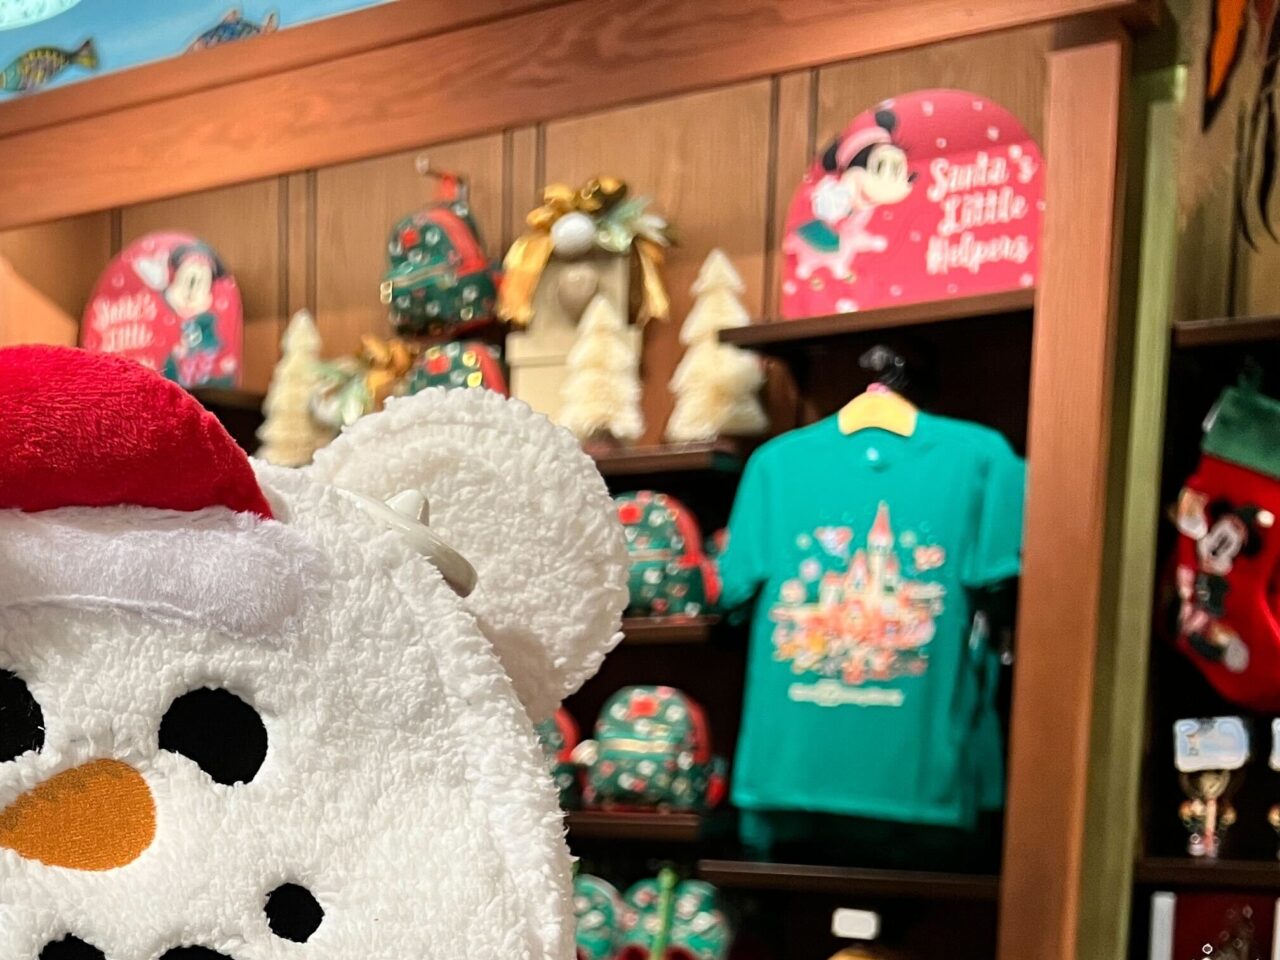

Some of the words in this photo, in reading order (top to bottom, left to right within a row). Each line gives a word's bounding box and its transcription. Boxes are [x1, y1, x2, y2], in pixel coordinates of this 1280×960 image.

[927, 146, 1038, 202] Santa's
[937, 186, 1028, 237] Little
[926, 231, 1034, 275] Helpers
